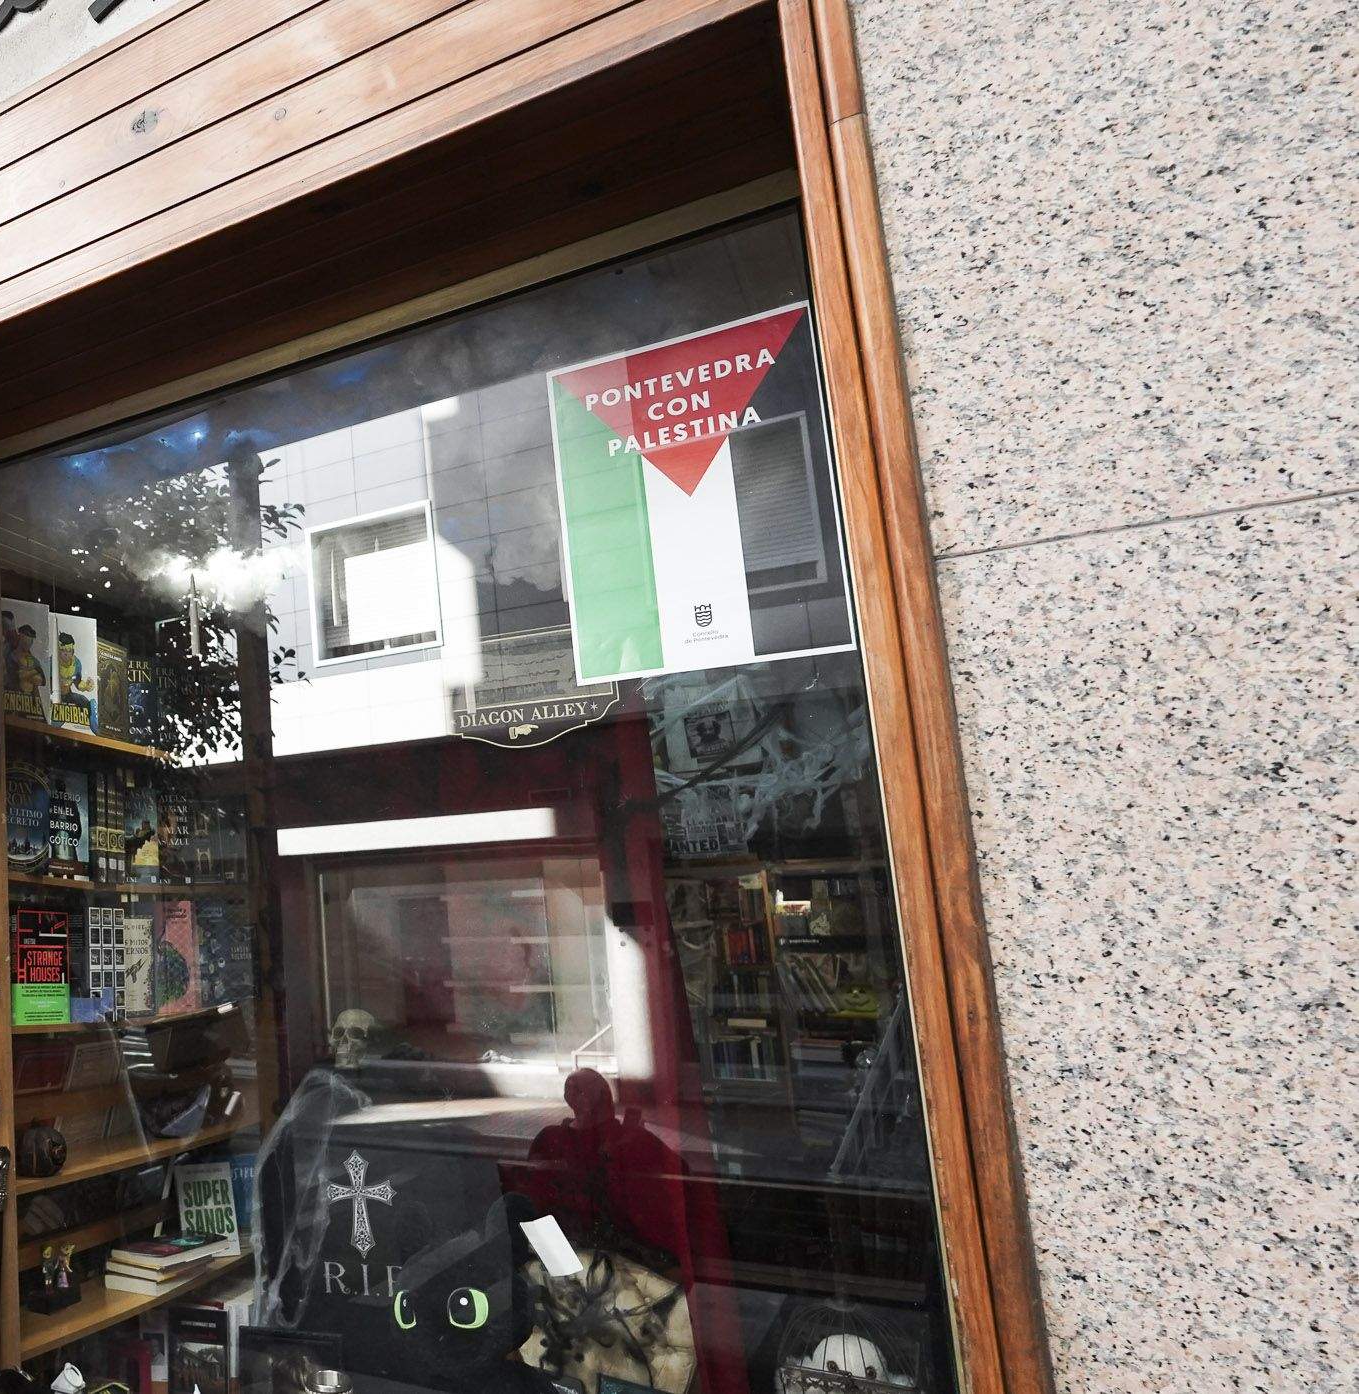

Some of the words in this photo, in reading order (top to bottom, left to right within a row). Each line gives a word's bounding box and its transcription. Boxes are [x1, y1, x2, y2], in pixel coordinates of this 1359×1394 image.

[585, 347, 776, 412] PONTEVEDRA
[647, 389, 711, 422] CON
[608, 405, 763, 457] PALESTINA
[458, 708, 525, 728] DIAGON
[531, 702, 588, 721] ALLEY
[65, 807, 75, 817] EL
[49, 820, 79, 832] BARRIO
[26, 950, 63, 967] STRANGE
[30, 966, 61, 982] HOUSES
[183, 1178, 231, 1208] SUPER
[184, 1206, 235, 1235] SANOS
